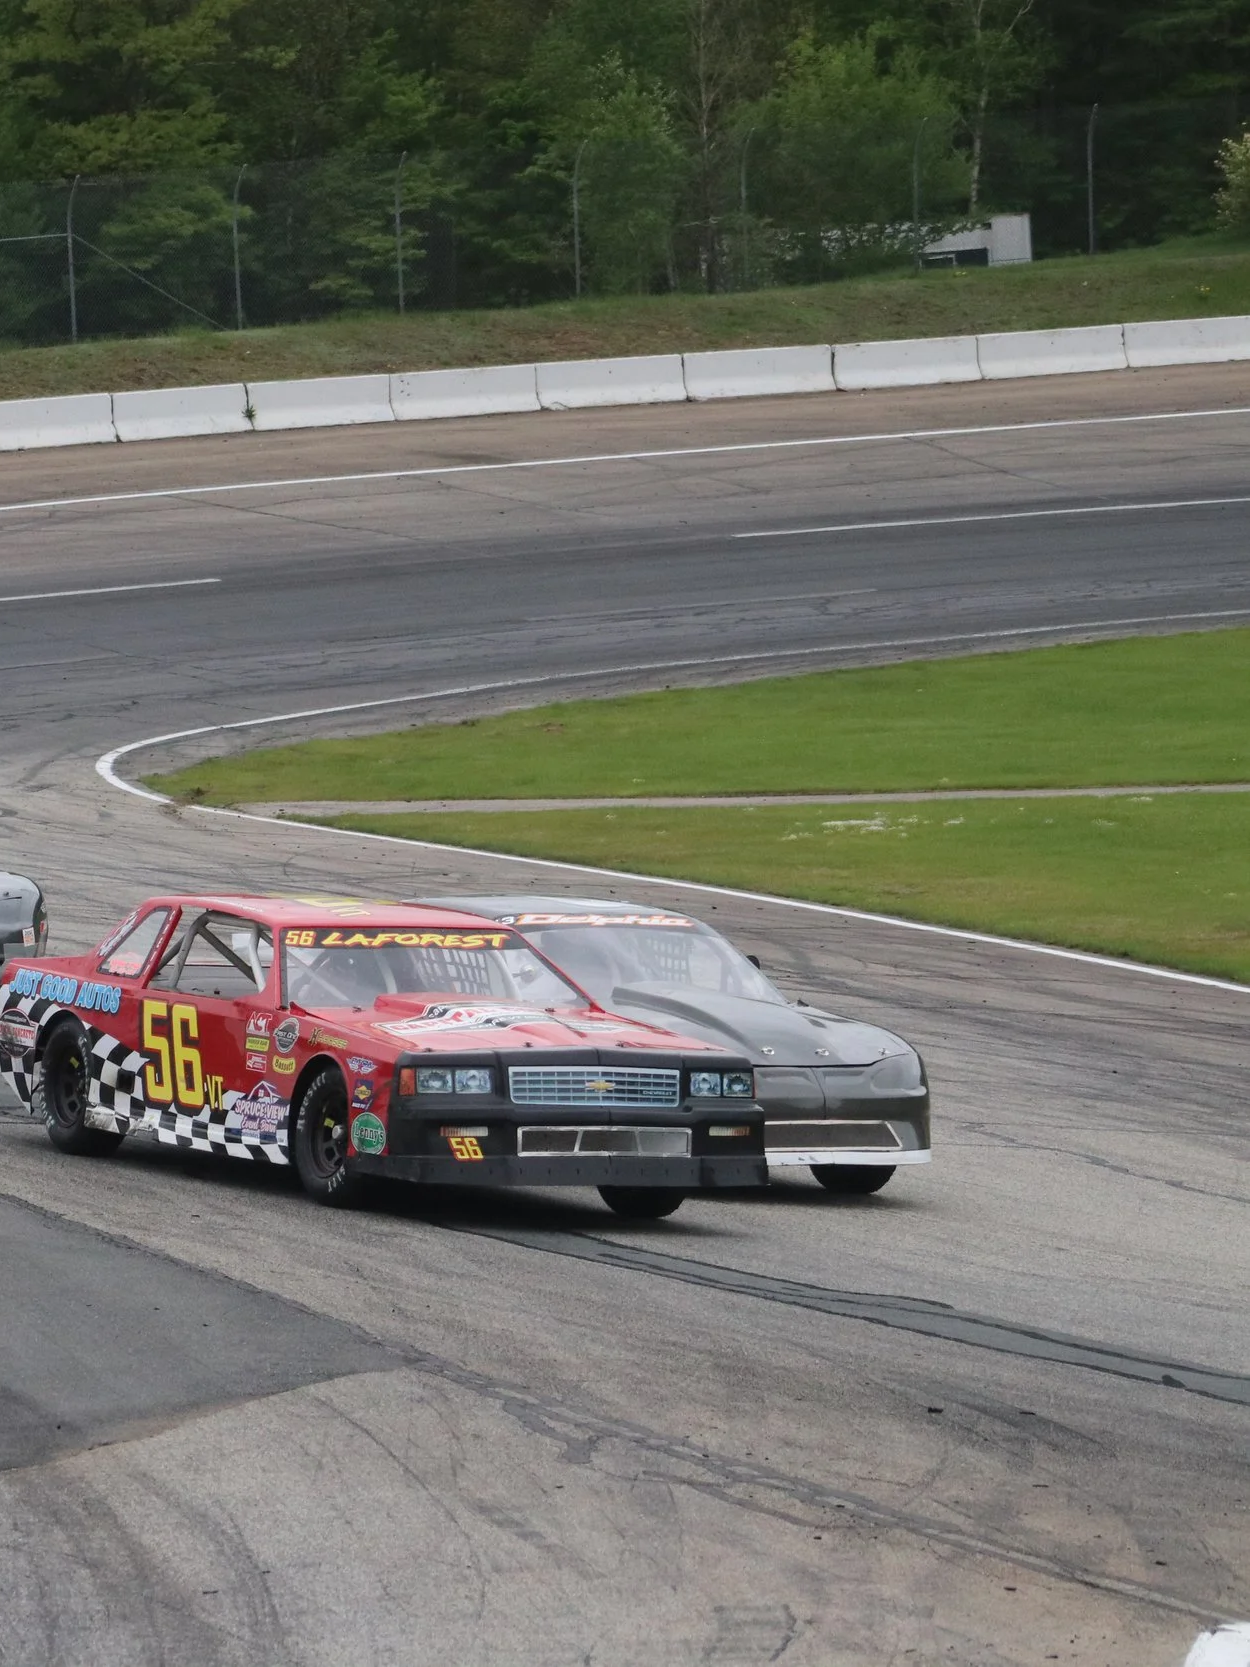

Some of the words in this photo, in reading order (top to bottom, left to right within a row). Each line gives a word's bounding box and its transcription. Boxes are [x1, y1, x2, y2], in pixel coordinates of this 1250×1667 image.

[285, 929, 316, 947] 56
[321, 931, 512, 949] LAFOREST
[9, 968, 44, 999] JUST
[40, 974, 78, 1004] GOOD
[74, 981, 122, 1014] AUTOS
[141, 999, 206, 1107] 56
[206, 1074, 224, 1111] VT
[235, 1099, 266, 1116] SPRUCE
[265, 1103, 287, 1121] VIEW
[354, 1122, 385, 1145] Lenny's
[449, 1137, 484, 1162] 56
